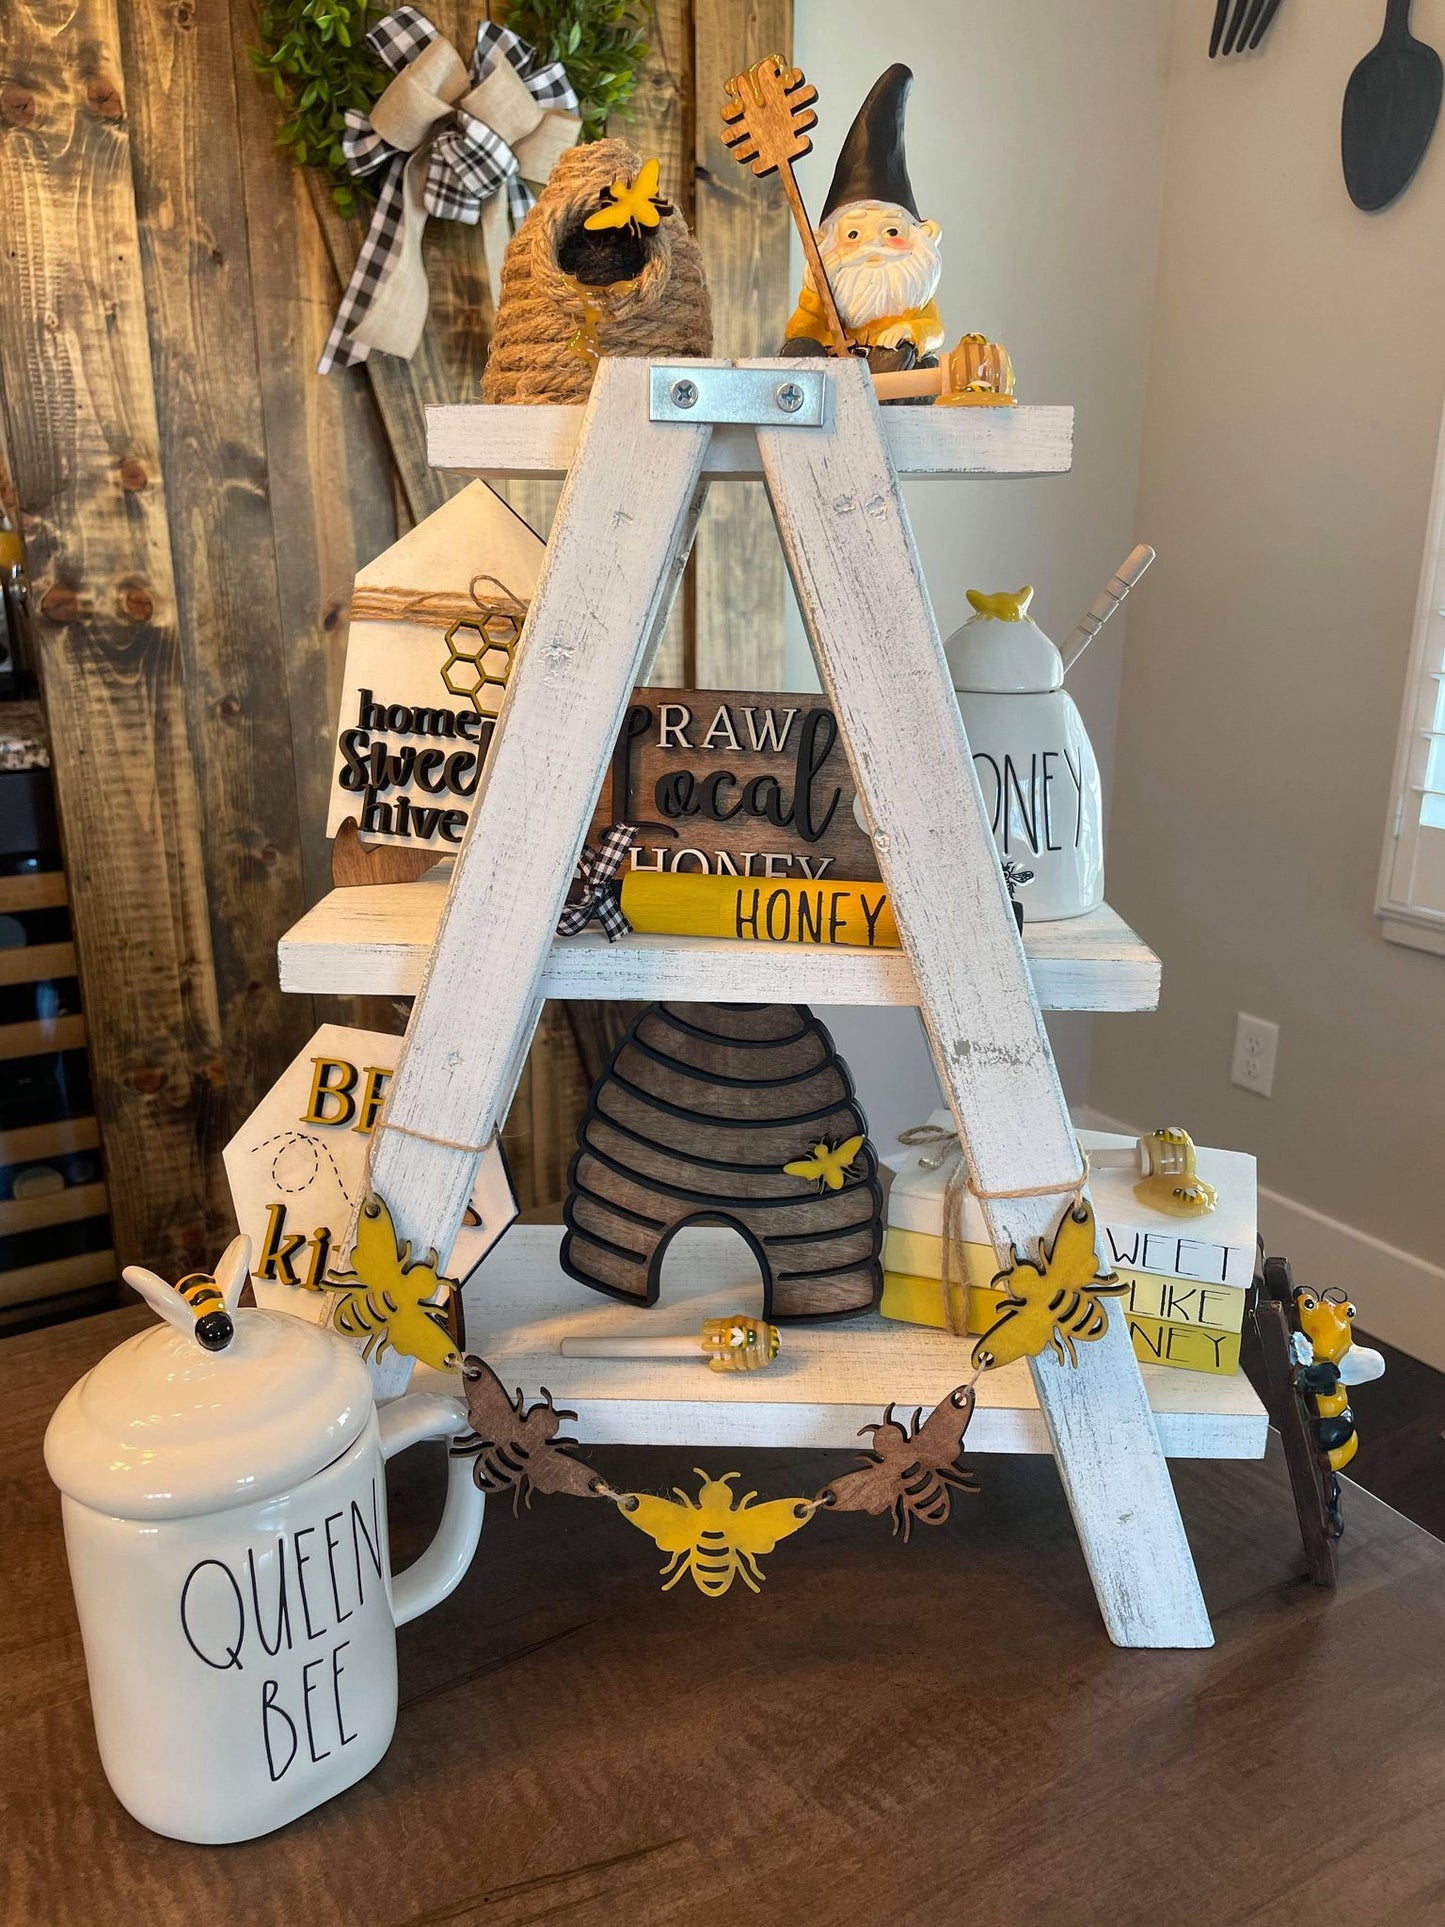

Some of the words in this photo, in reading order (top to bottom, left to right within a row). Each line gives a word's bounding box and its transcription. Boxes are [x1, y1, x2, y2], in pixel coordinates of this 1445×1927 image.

[356, 688, 482, 740] home
[655, 704, 798, 752] RAW
[602, 704, 842, 842] Local
[972, 746, 1082, 854] ONEY
[358, 783, 469, 843] hive
[736, 888, 887, 946] HONEY
[1106, 1227, 1241, 1281] WEET
[1129, 1279, 1231, 1326] LIKE
[1130, 1321, 1226, 1368] NEY
[181, 1478, 382, 1670] QUEEN
[263, 1640, 358, 1782] BEE
